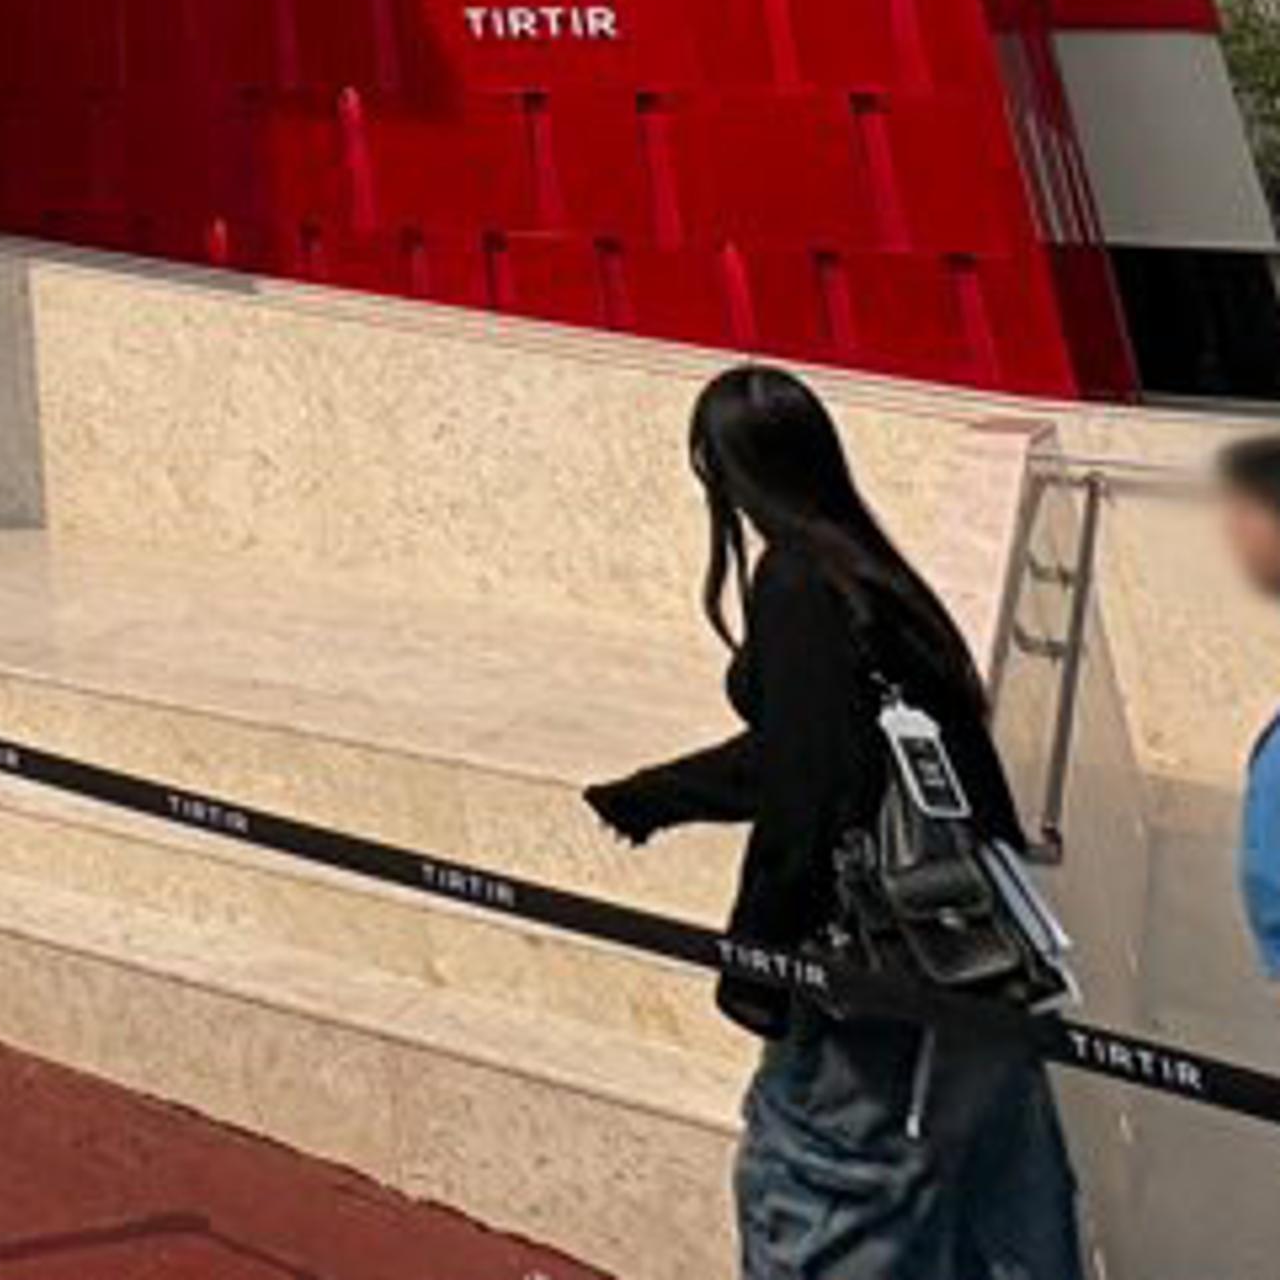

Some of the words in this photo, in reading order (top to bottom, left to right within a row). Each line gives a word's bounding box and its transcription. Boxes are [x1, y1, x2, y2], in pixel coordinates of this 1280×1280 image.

[463, 5, 617, 39] TIRTIR
[165, 794, 249, 833] TIRTIR
[420, 863, 515, 907] TIRTIR
[716, 940, 828, 990] TIRTIR
[1066, 1030, 1202, 1090] TIRTIR
